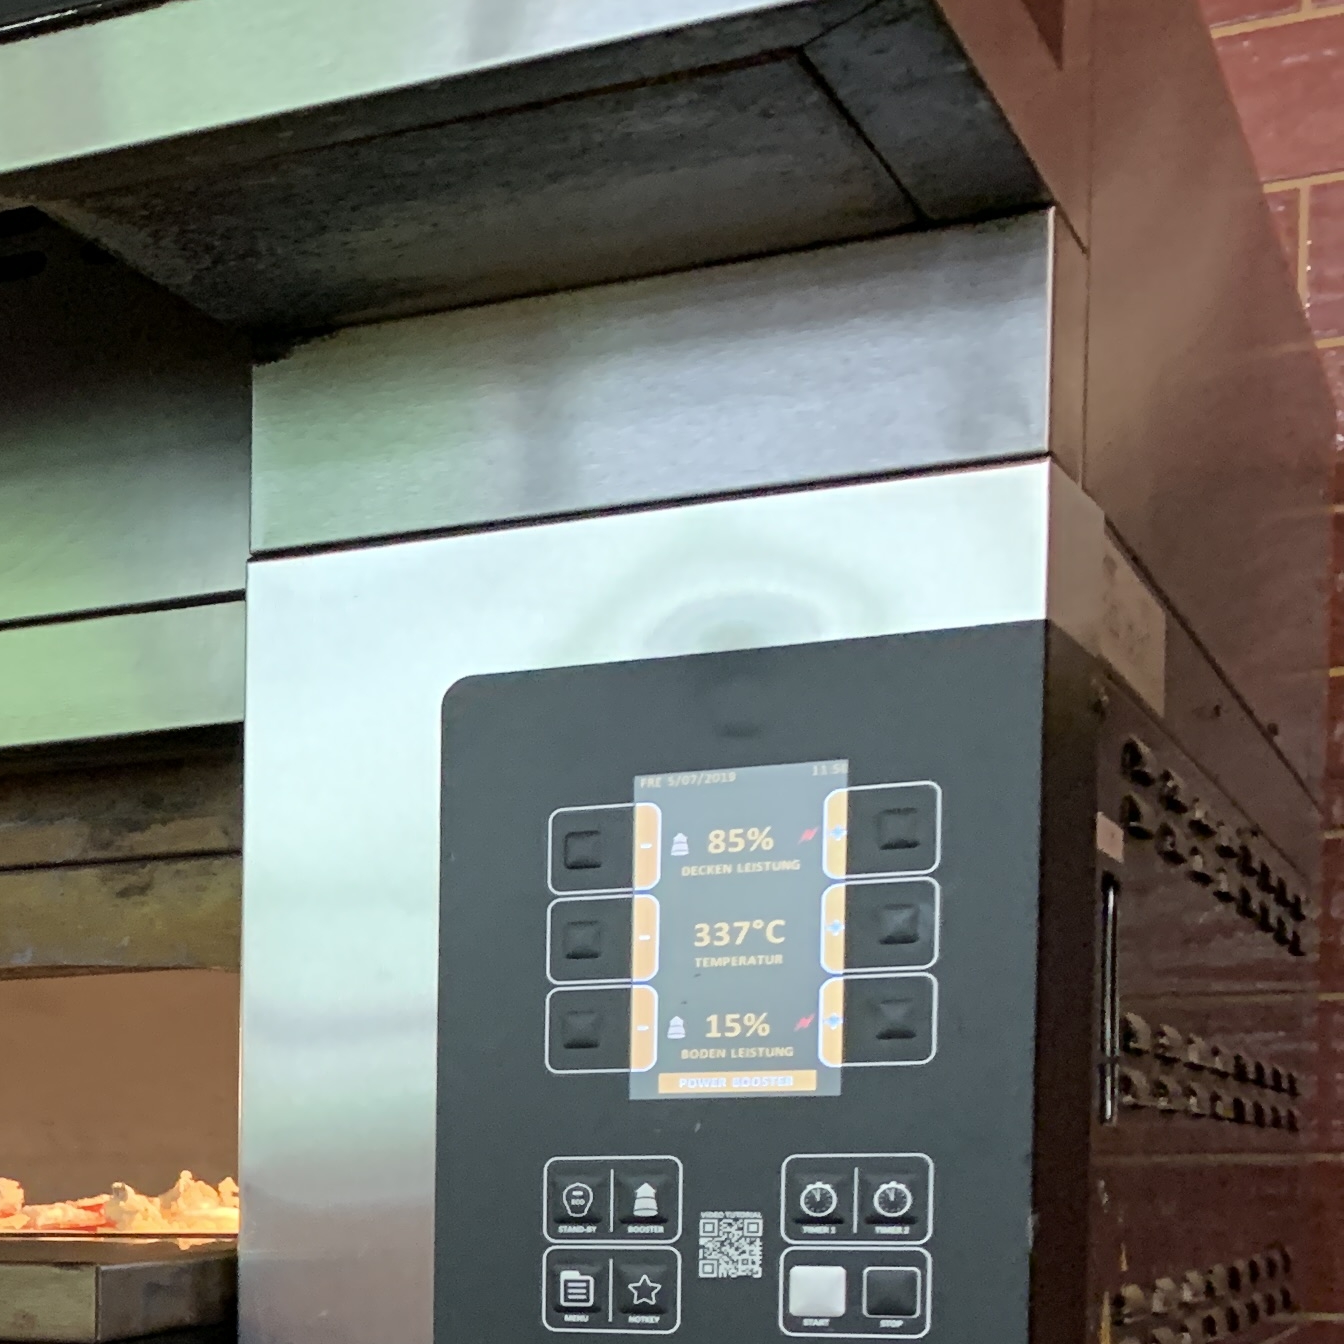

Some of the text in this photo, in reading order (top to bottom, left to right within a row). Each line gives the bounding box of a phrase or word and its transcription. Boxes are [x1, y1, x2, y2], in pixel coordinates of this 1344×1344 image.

[640, 776, 662, 788] FRE
[707, 825, 774, 854] 85%
[681, 859, 801, 877] DECKEN LEISTUNG
[693, 919, 787, 948] 337°C
[694, 954, 784, 968] TEMPERATUR
[705, 1013, 771, 1039] 15%
[681, 1045, 794, 1060] BODEN LEISTUNG
[678, 1074, 794, 1089] POWER BOOSTER
